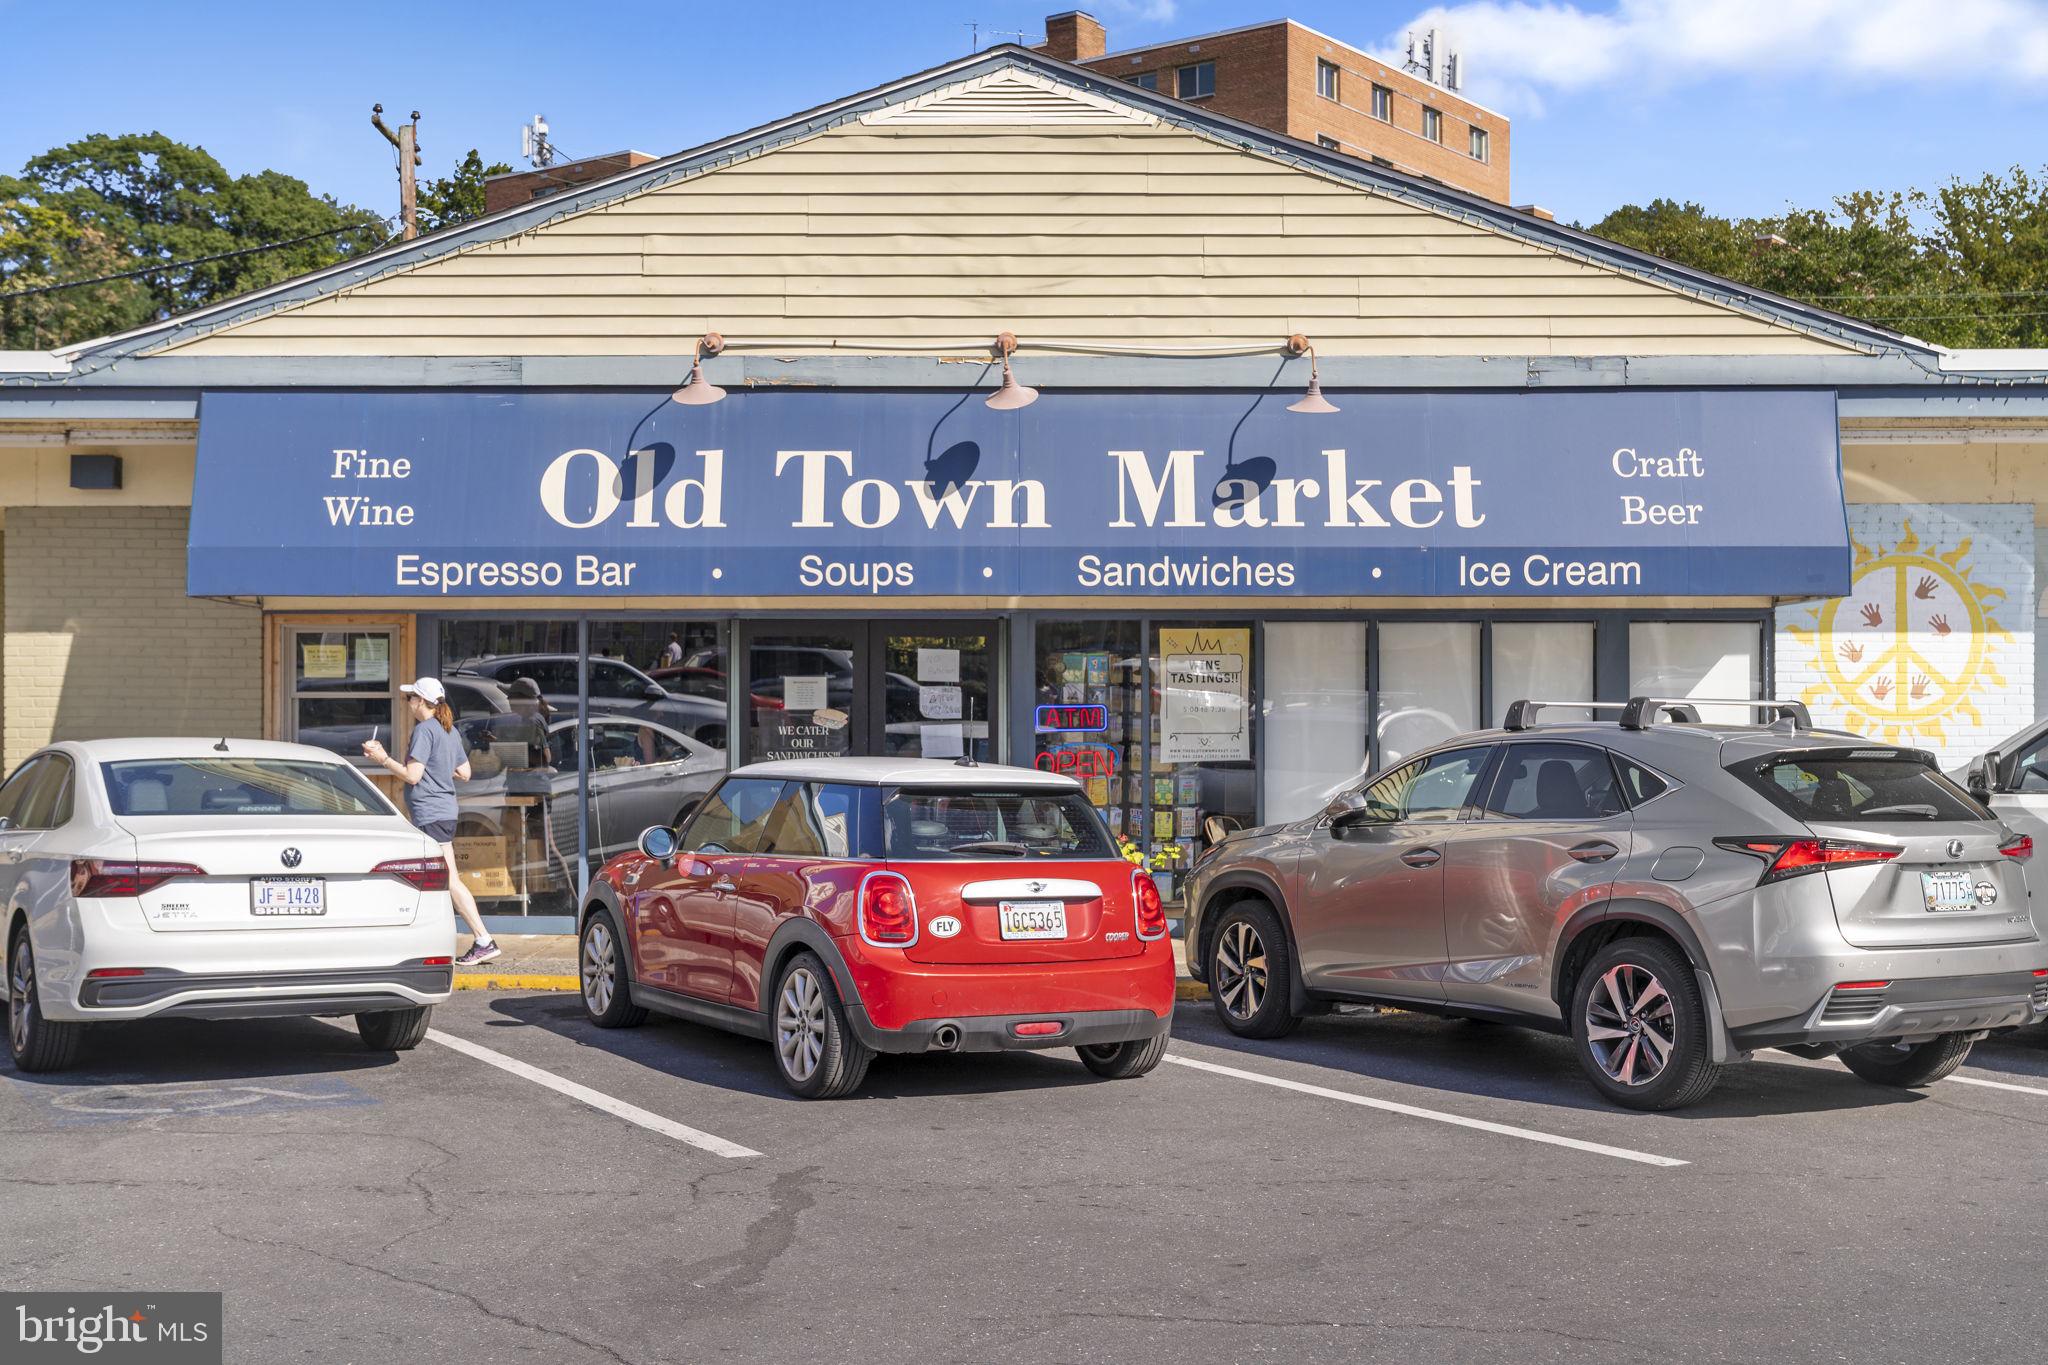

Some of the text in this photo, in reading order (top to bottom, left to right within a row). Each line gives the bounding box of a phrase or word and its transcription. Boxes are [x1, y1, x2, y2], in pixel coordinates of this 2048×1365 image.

[331, 450, 411, 479] Fine
[1612, 448, 1705, 478] Craft
[540, 449, 1486, 529] Old Town Market
[323, 497, 414, 525] Wine
[1621, 496, 1704, 525] Beer
[396, 555, 636, 593] Espresso Bar
[799, 555, 914, 593] Soups
[1077, 555, 1295, 587] Sandwiches
[1460, 555, 1641, 586] Ice Cream
[1171, 672, 1239, 684] TASTINGS!!
[1189, 660, 1221, 670] WINE
[778, 725, 829, 736] WE CATER
[1045, 708, 1101, 728] ATM
[791, 738, 814, 748] OUR
[1034, 750, 1114, 777] OPEN
[255, 907, 325, 915] SHEEHY
[1005, 912, 1061, 931] 1GC5365
[936, 922, 954, 932] FLY
